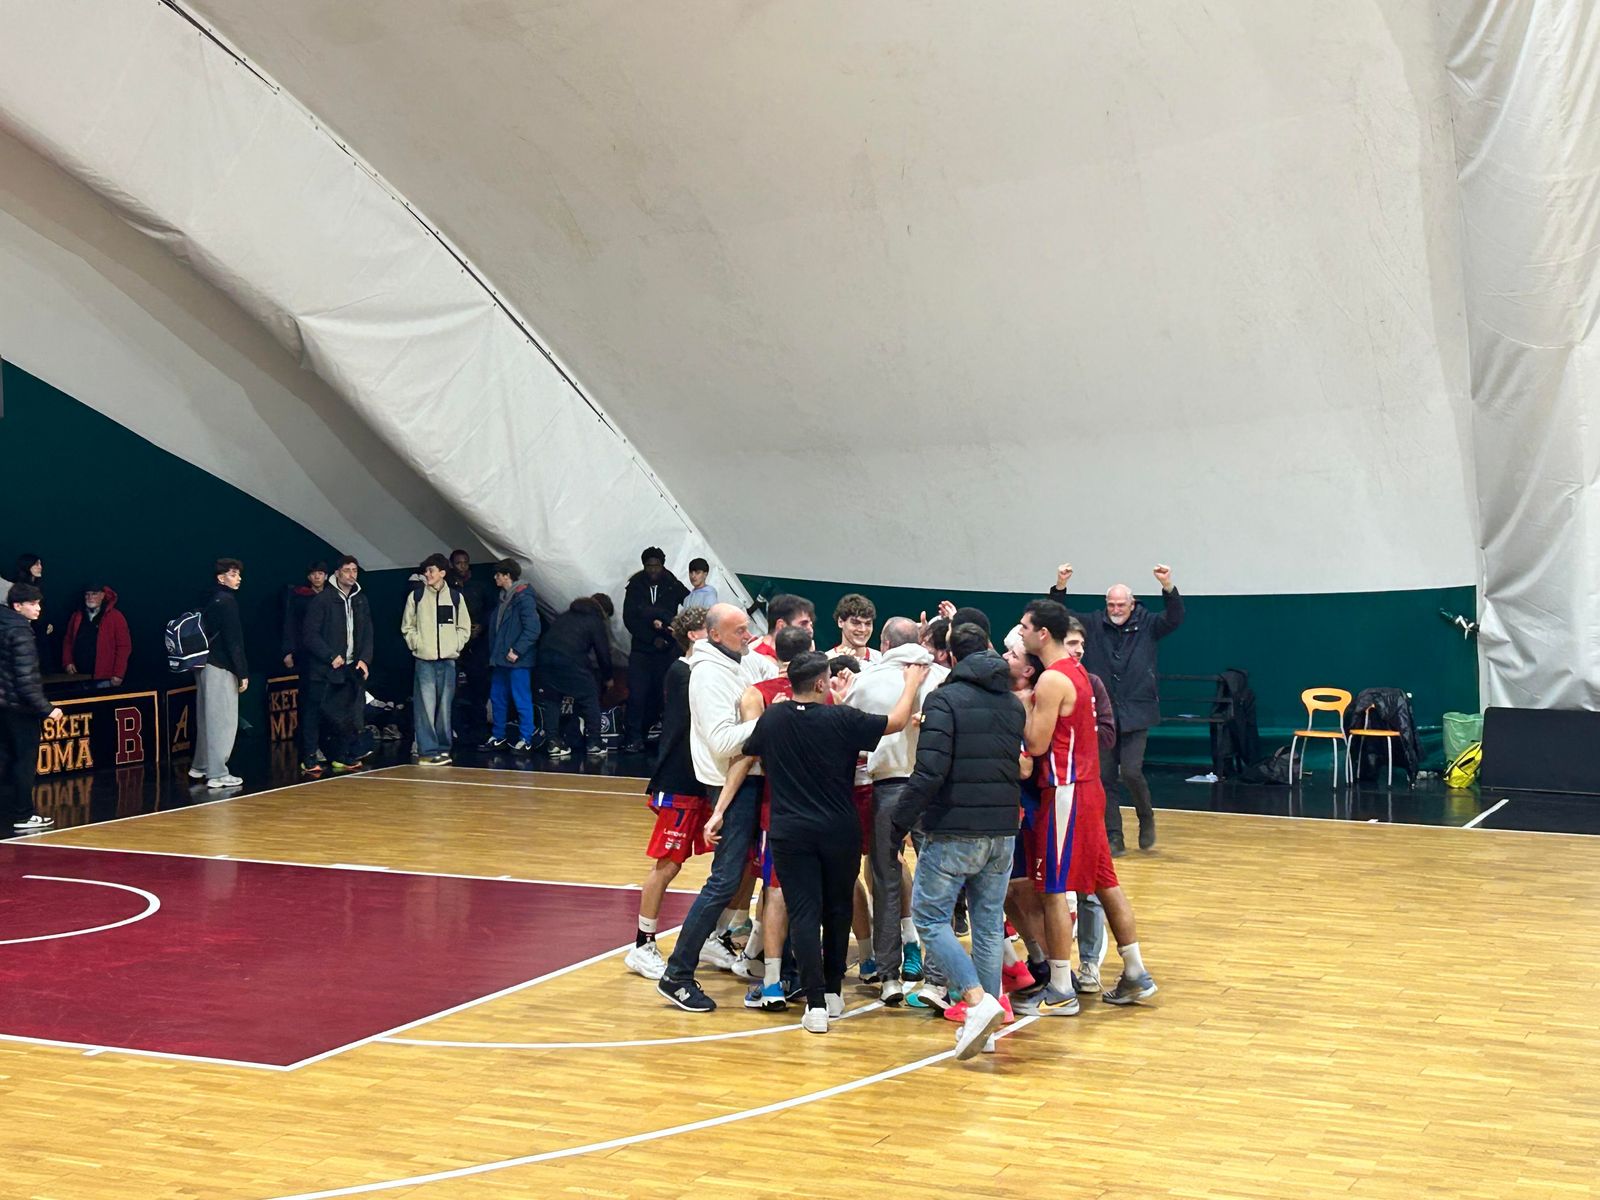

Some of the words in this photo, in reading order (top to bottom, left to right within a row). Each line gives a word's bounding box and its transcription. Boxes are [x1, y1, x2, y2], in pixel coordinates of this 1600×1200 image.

[270, 689, 299, 712] KET
[41, 712, 93, 741] SKET
[115, 706, 144, 765] B
[36, 737, 94, 775] OMA
